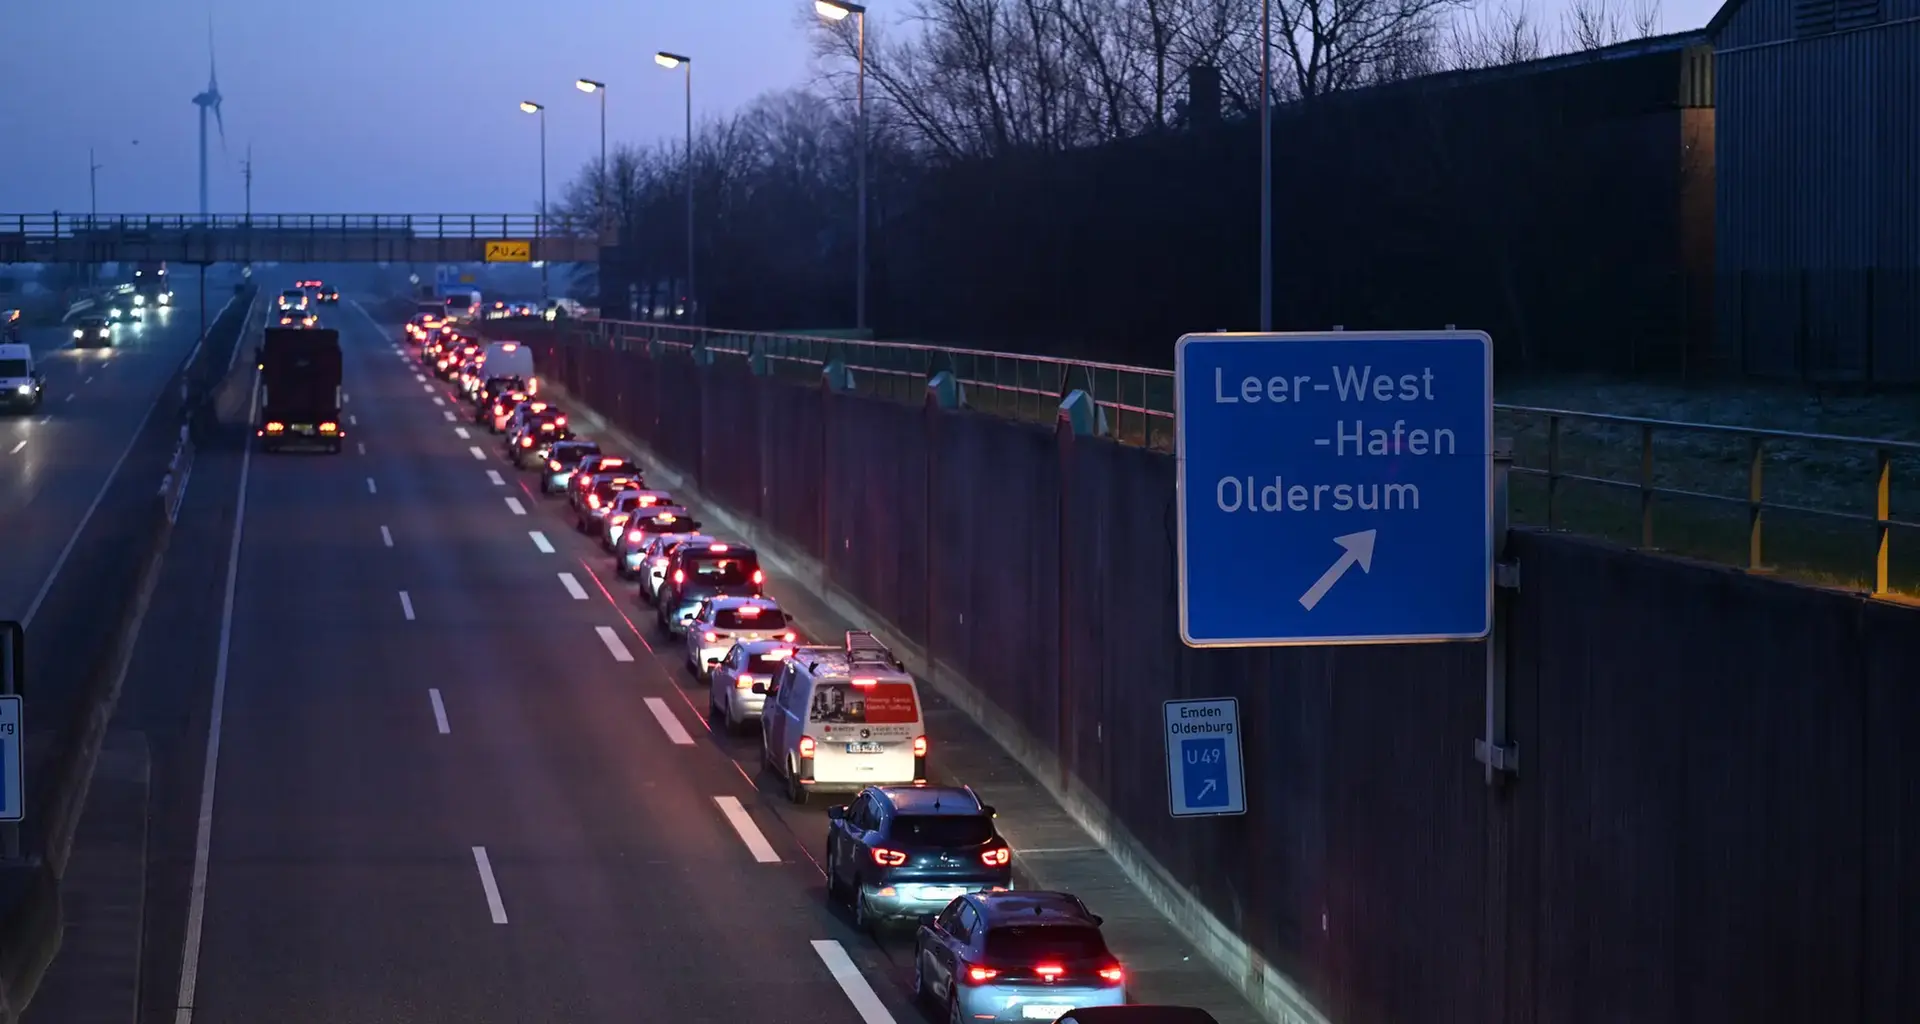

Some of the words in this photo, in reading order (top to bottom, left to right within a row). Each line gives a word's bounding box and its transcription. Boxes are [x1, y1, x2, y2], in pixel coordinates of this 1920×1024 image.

[1215, 365, 1435, 403] Leer-West
[1314, 419, 1455, 456] -Hafen
[1216, 475, 1419, 513] Oldersum
[1171, 722, 1234, 734] Oldenburg
[1180, 707, 1222, 719] Emden
